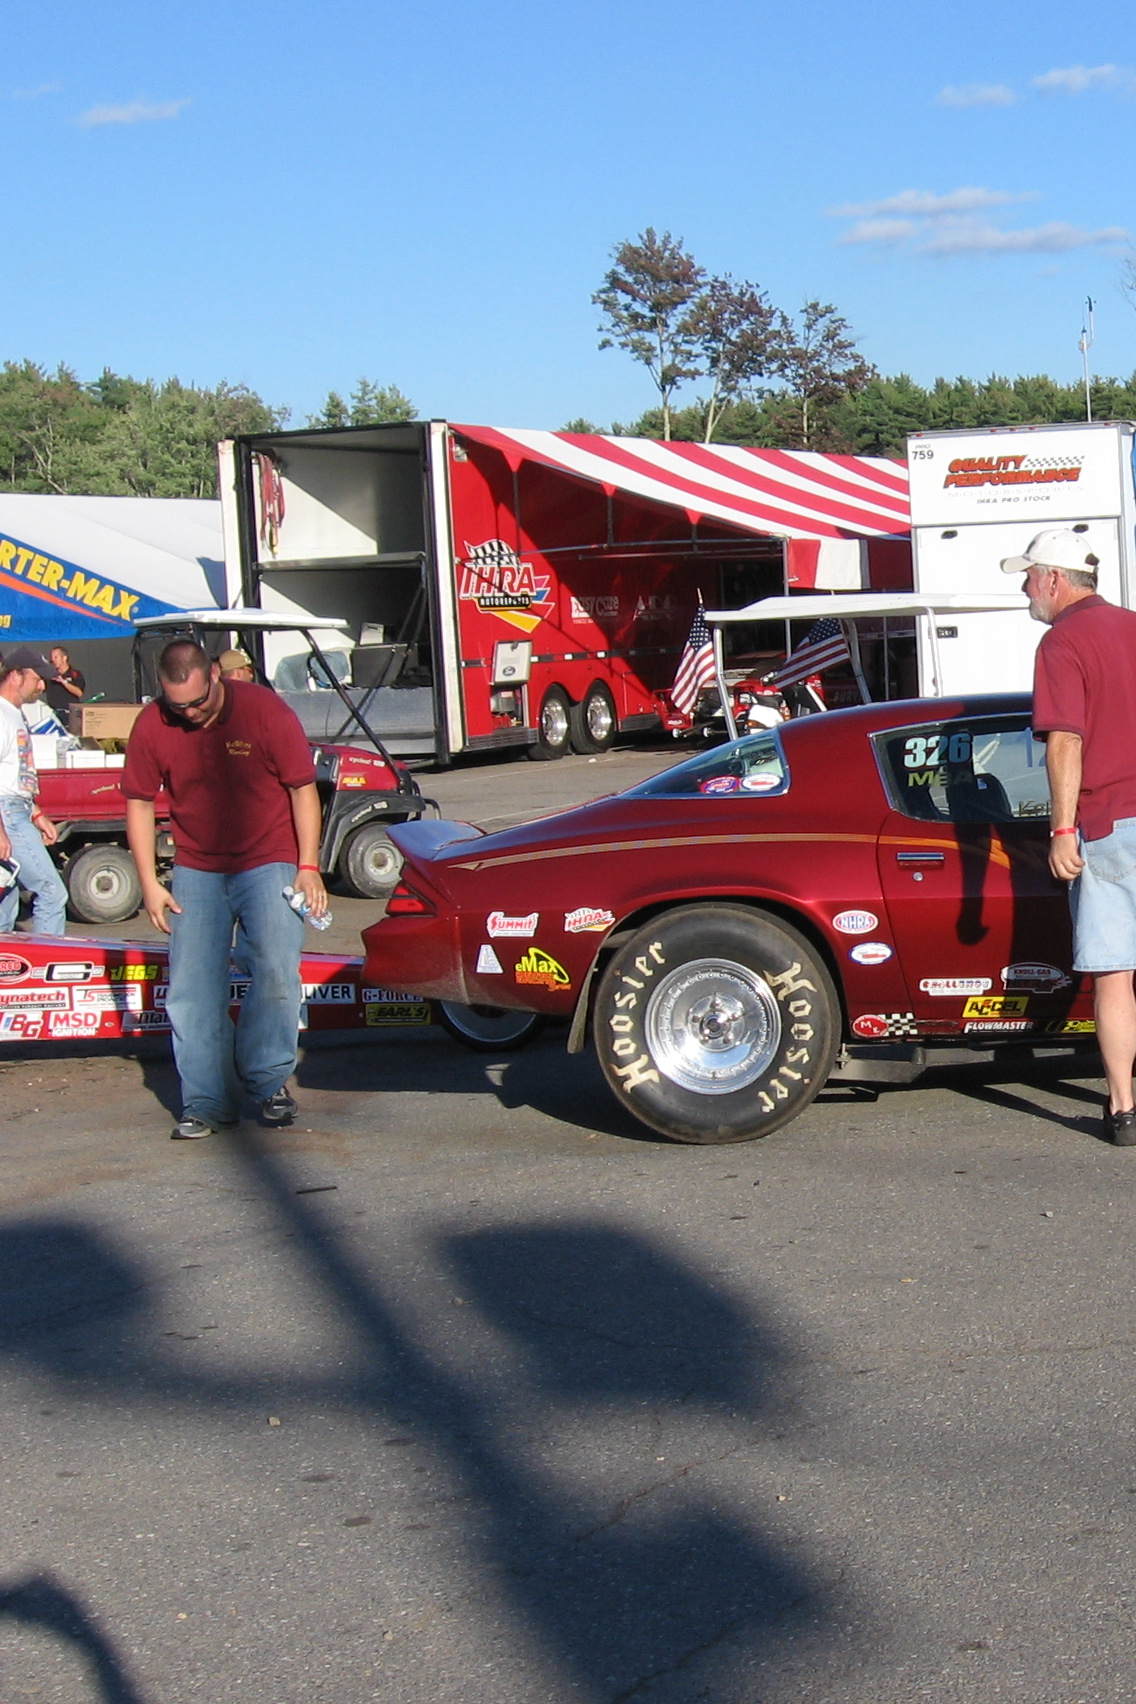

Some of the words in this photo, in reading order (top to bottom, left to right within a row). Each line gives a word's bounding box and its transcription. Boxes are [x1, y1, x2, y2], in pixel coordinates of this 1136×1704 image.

[912, 450, 934, 460] 759
[949, 455, 1027, 473] QUALITY
[943, 467, 1082, 488] PERFORMANCE
[461, 563, 538, 597] IHRA
[904, 732, 971, 768] 326
[839, 916, 871, 929] NHRA
[110, 965, 158, 980] JEGS
[54, 1012, 97, 1027] MSD
[608, 941, 666, 1094] Hoosier
[964, 1021, 1034, 1033] FLOWMASTER
[758, 962, 817, 1113] Hoosier
